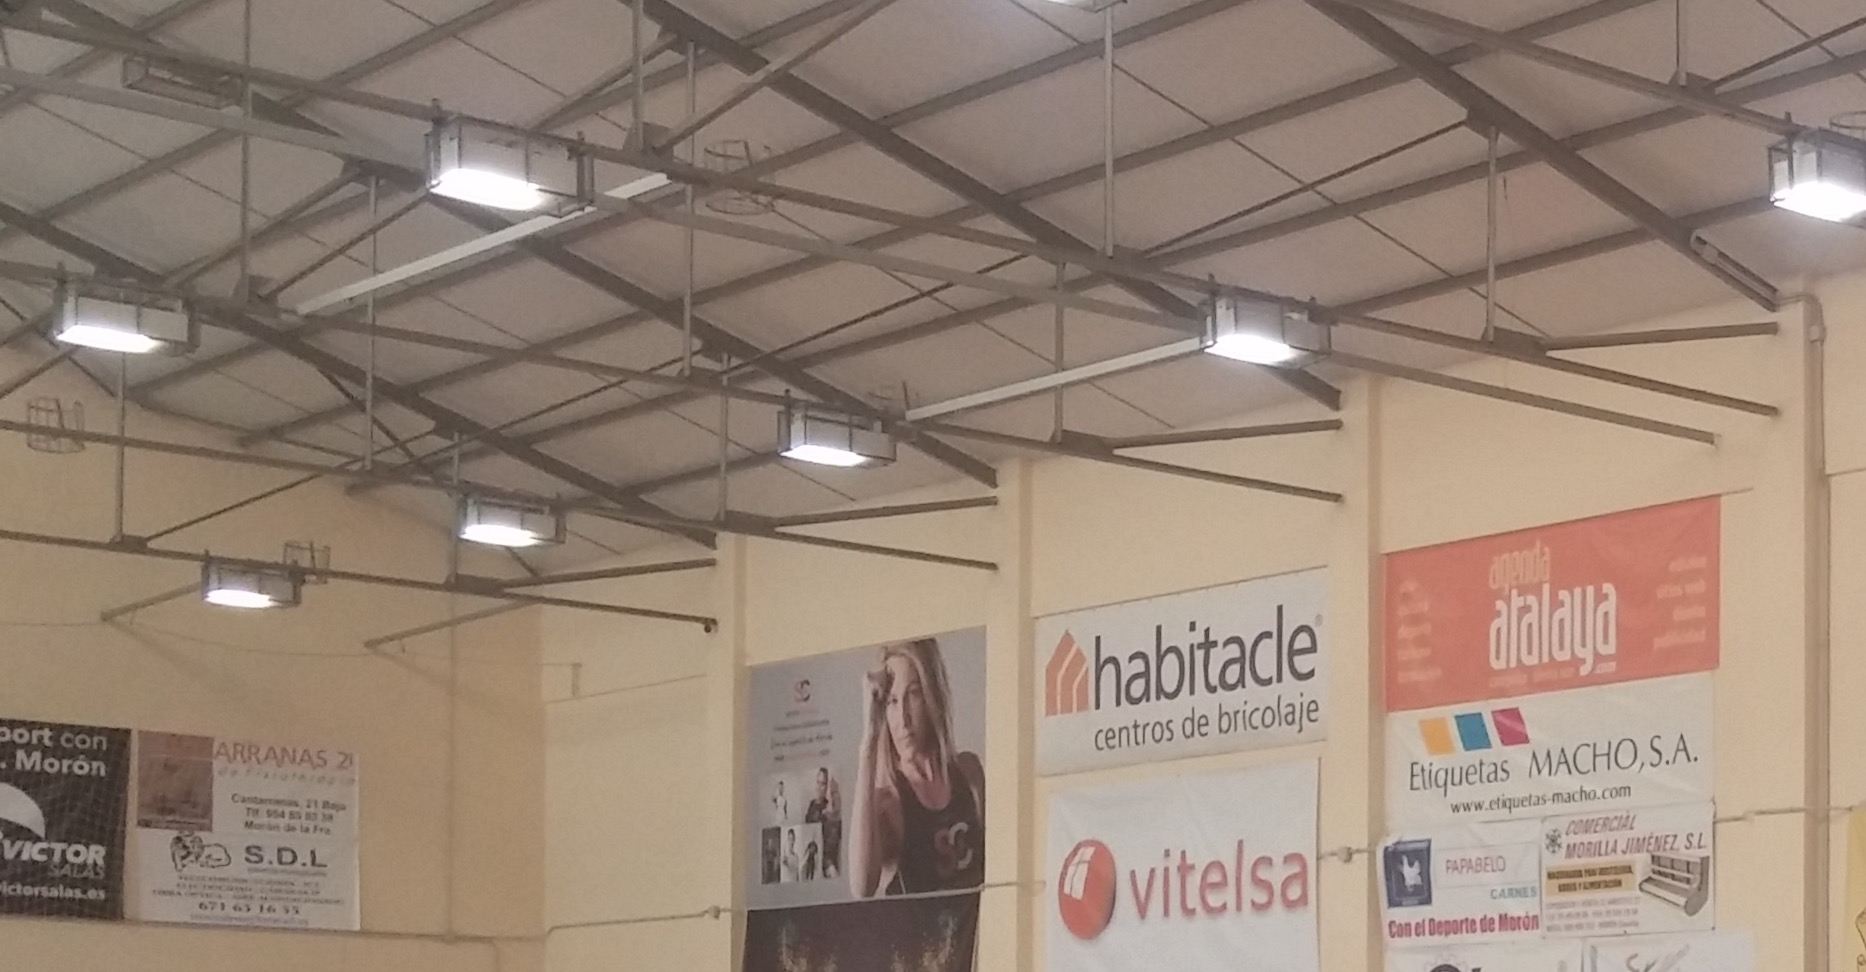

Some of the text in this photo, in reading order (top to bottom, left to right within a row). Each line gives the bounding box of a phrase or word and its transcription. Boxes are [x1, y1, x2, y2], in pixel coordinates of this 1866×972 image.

[1489, 539, 1550, 595] agenda
[1489, 582, 1617, 677] atalaya
[1094, 604, 1318, 711] habitacle
[1094, 694, 1320, 751] centros de bricolaje
[60, 732, 107, 751] con
[15, 749, 106, 777] Morón
[1410, 757, 1511, 797] Etiquetas
[1450, 785, 1632, 814] www.etiquetas-macho.com
[1565, 813, 1637, 836] COMERCIAL
[2, 839, 106, 866] VICTOR
[1565, 839, 1618, 860] MORILLA
[49, 863, 105, 880] SALAS
[1445, 855, 1506, 875] PAPABELO
[0, 880, 105, 900] ictorsalas.es
[1130, 840, 1309, 920] vitelsa
[1490, 886, 1537, 900] CARNES
[1388, 920, 1412, 938] Con
[1415, 918, 1425, 937] el
[1428, 915, 1477, 937] Deporte
[1479, 914, 1495, 933] de
[1498, 911, 1540, 932] Morón
